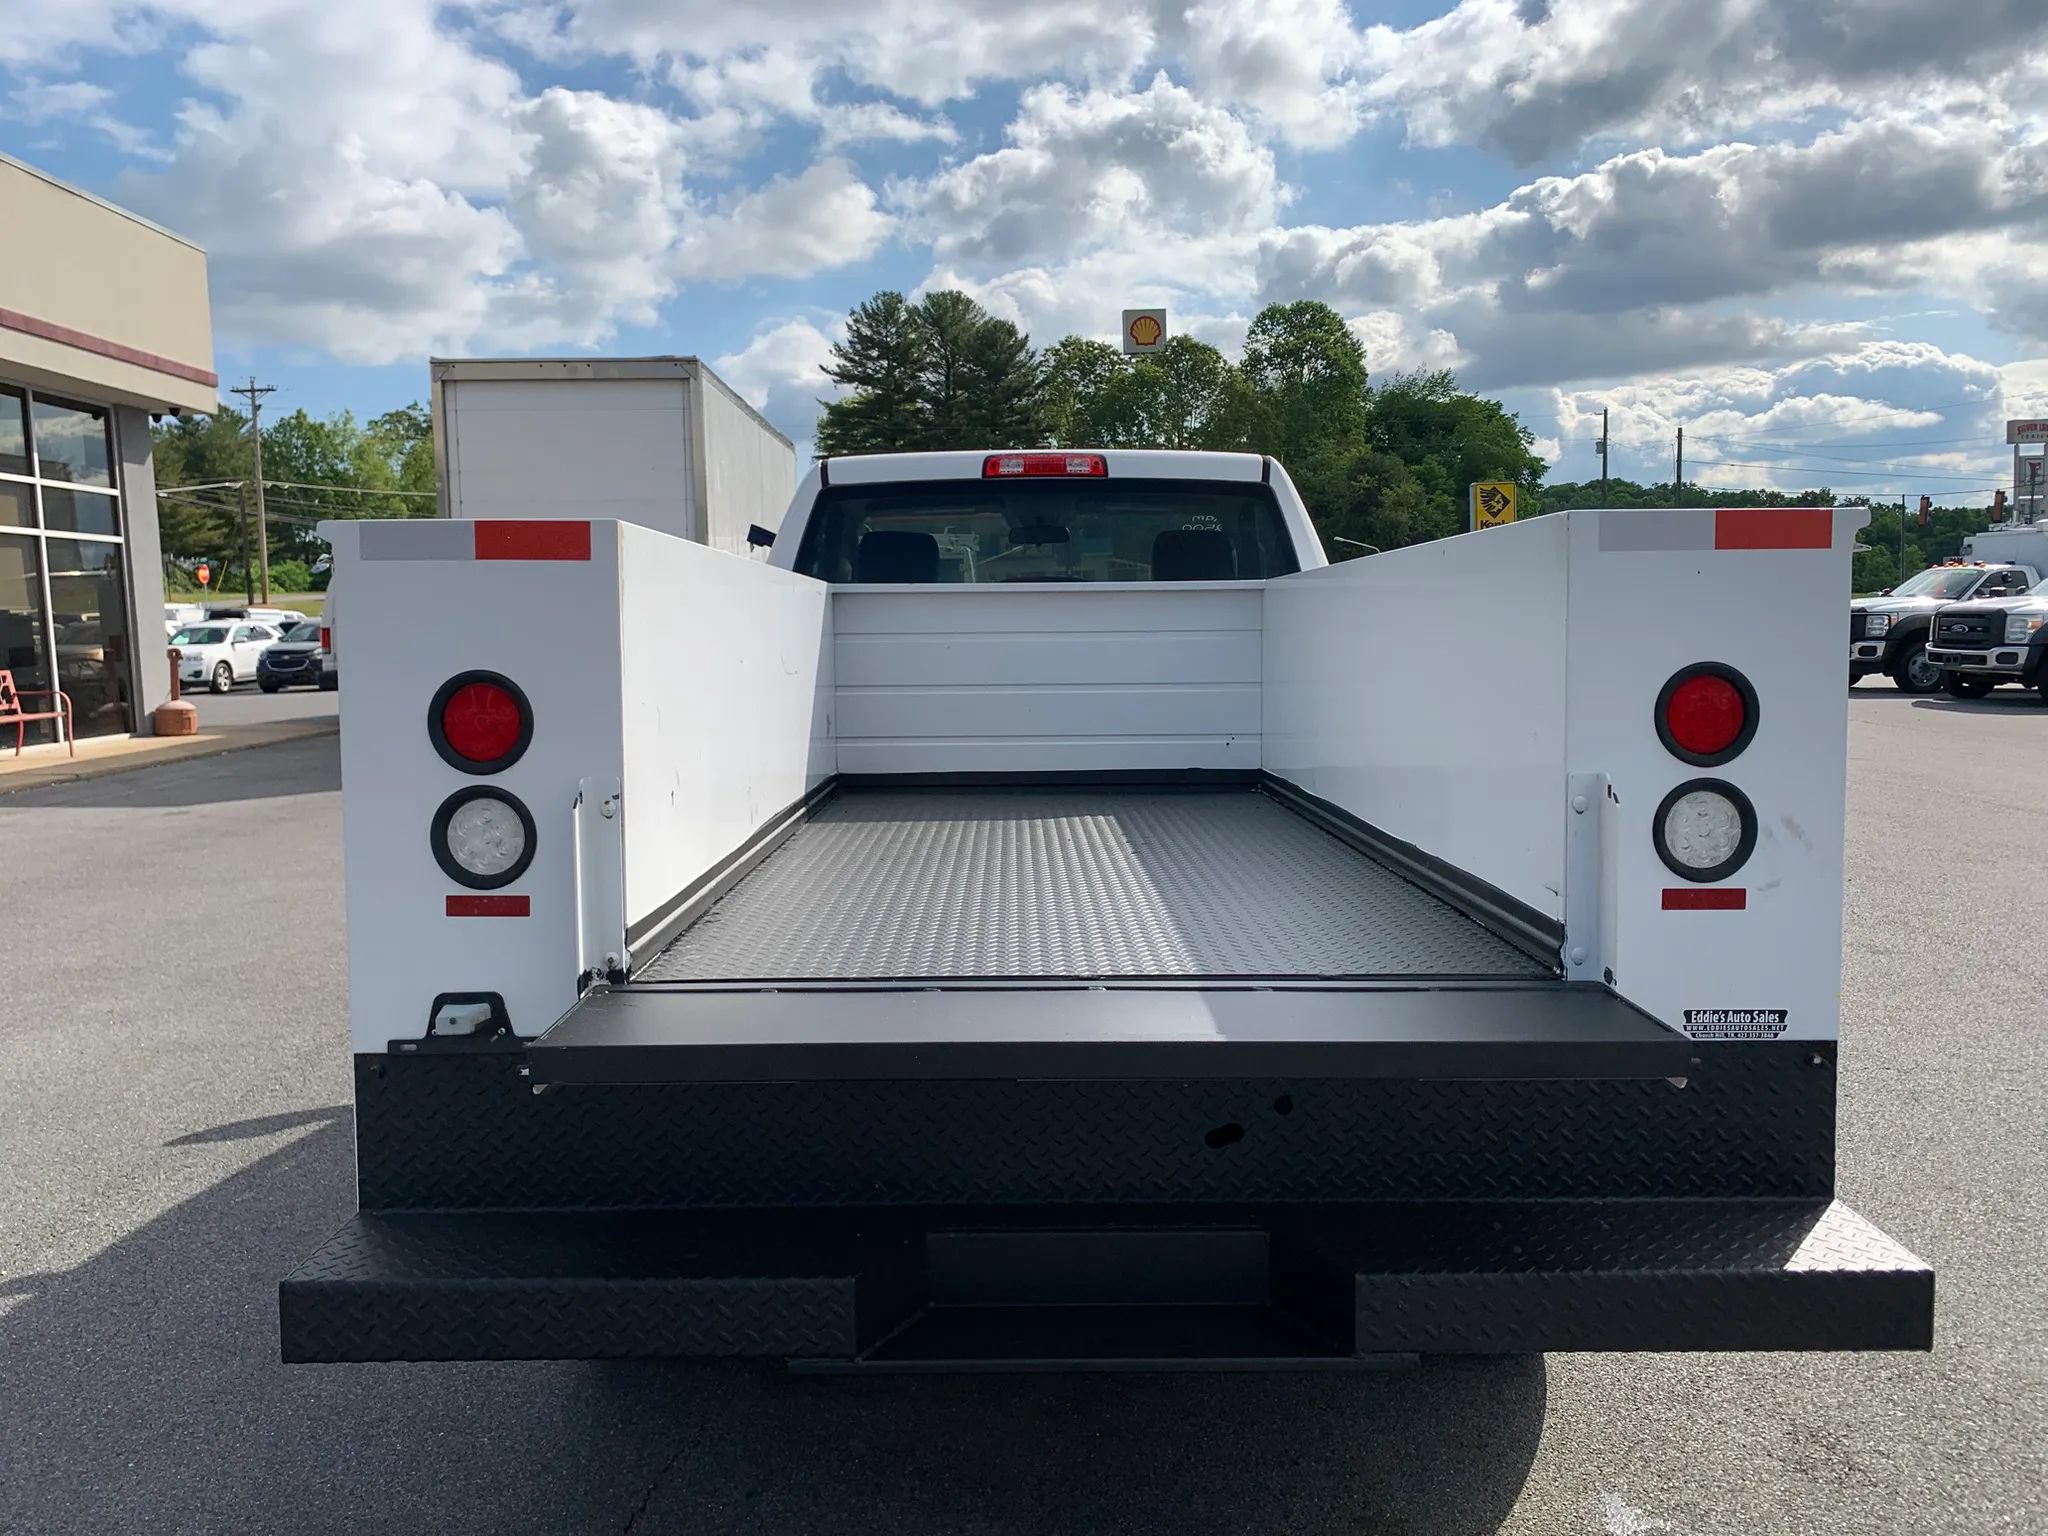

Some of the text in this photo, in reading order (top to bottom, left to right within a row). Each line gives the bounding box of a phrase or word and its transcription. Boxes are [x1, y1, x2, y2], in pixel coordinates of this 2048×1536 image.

[1691, 1010, 1779, 1023] Eddie's Auto Sales
